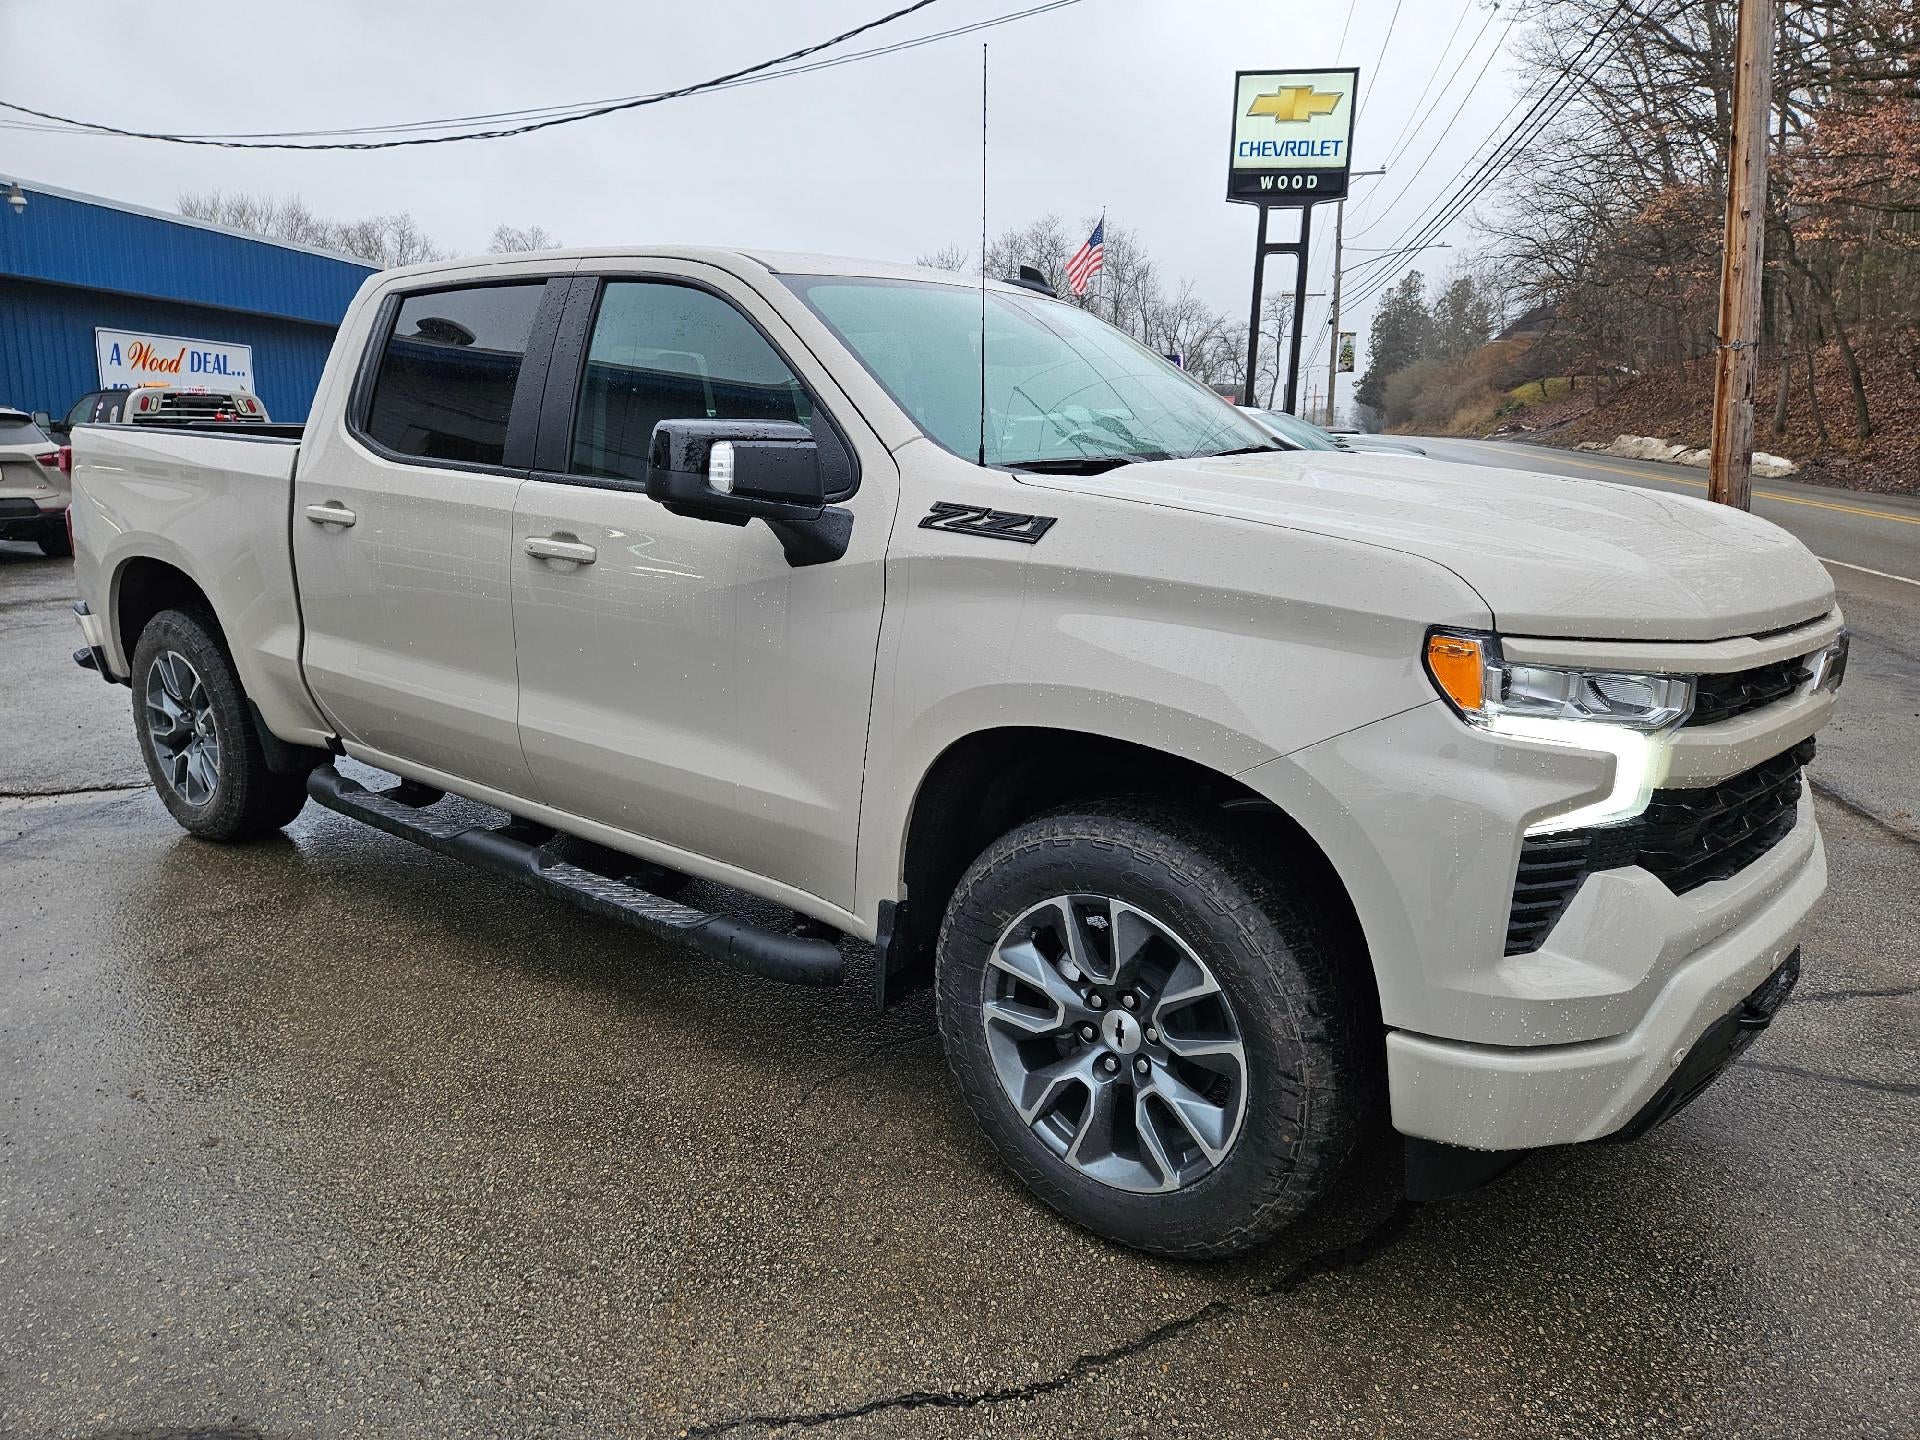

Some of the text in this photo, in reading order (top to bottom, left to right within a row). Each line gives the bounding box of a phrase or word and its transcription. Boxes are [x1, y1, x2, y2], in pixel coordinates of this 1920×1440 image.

[1239, 140, 1343, 157] CHEVROLET
[1260, 175, 1318, 190] WOOD
[109, 341, 246, 377] A Wood DEAL...
[917, 500, 1059, 545] Z71
